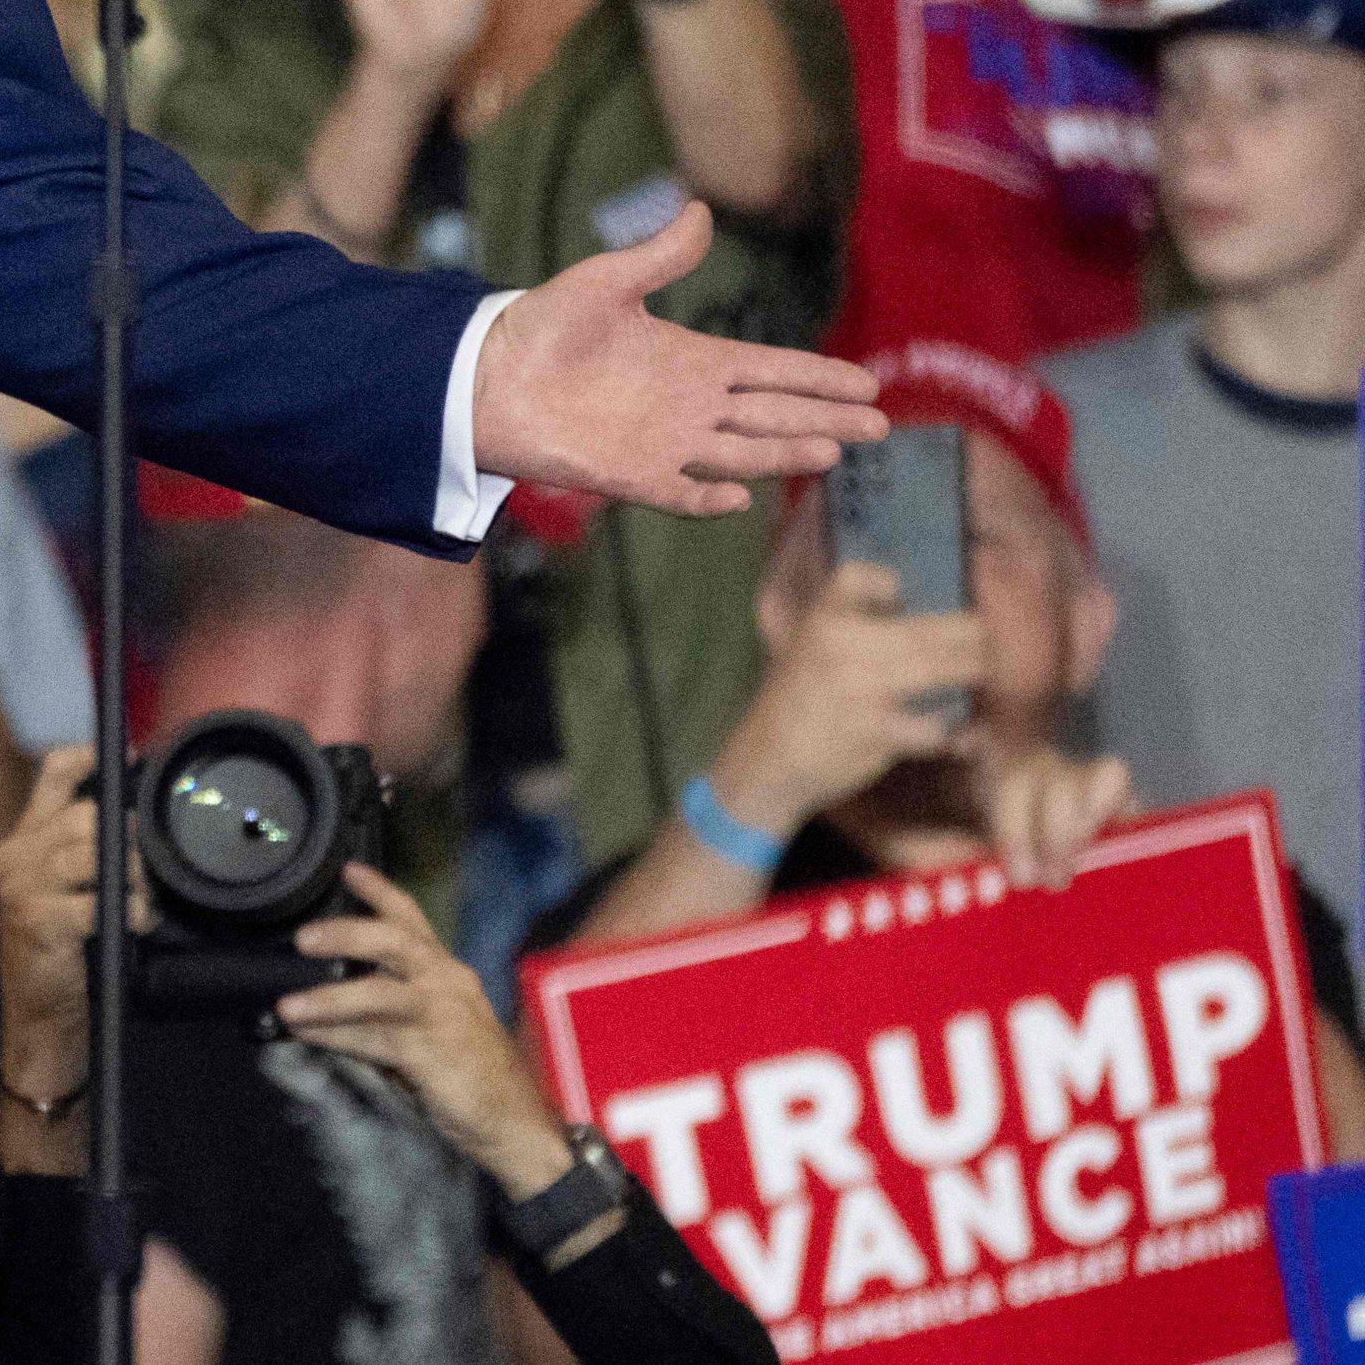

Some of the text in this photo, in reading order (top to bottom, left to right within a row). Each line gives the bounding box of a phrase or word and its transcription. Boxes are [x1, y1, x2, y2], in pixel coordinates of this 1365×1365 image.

[602, 949, 1270, 1229] TRUMP
[710, 1104, 1227, 1322] VANCE
[821, 1272, 1001, 1353] AMERICA
[1005, 1241, 1129, 1308] GREAT
